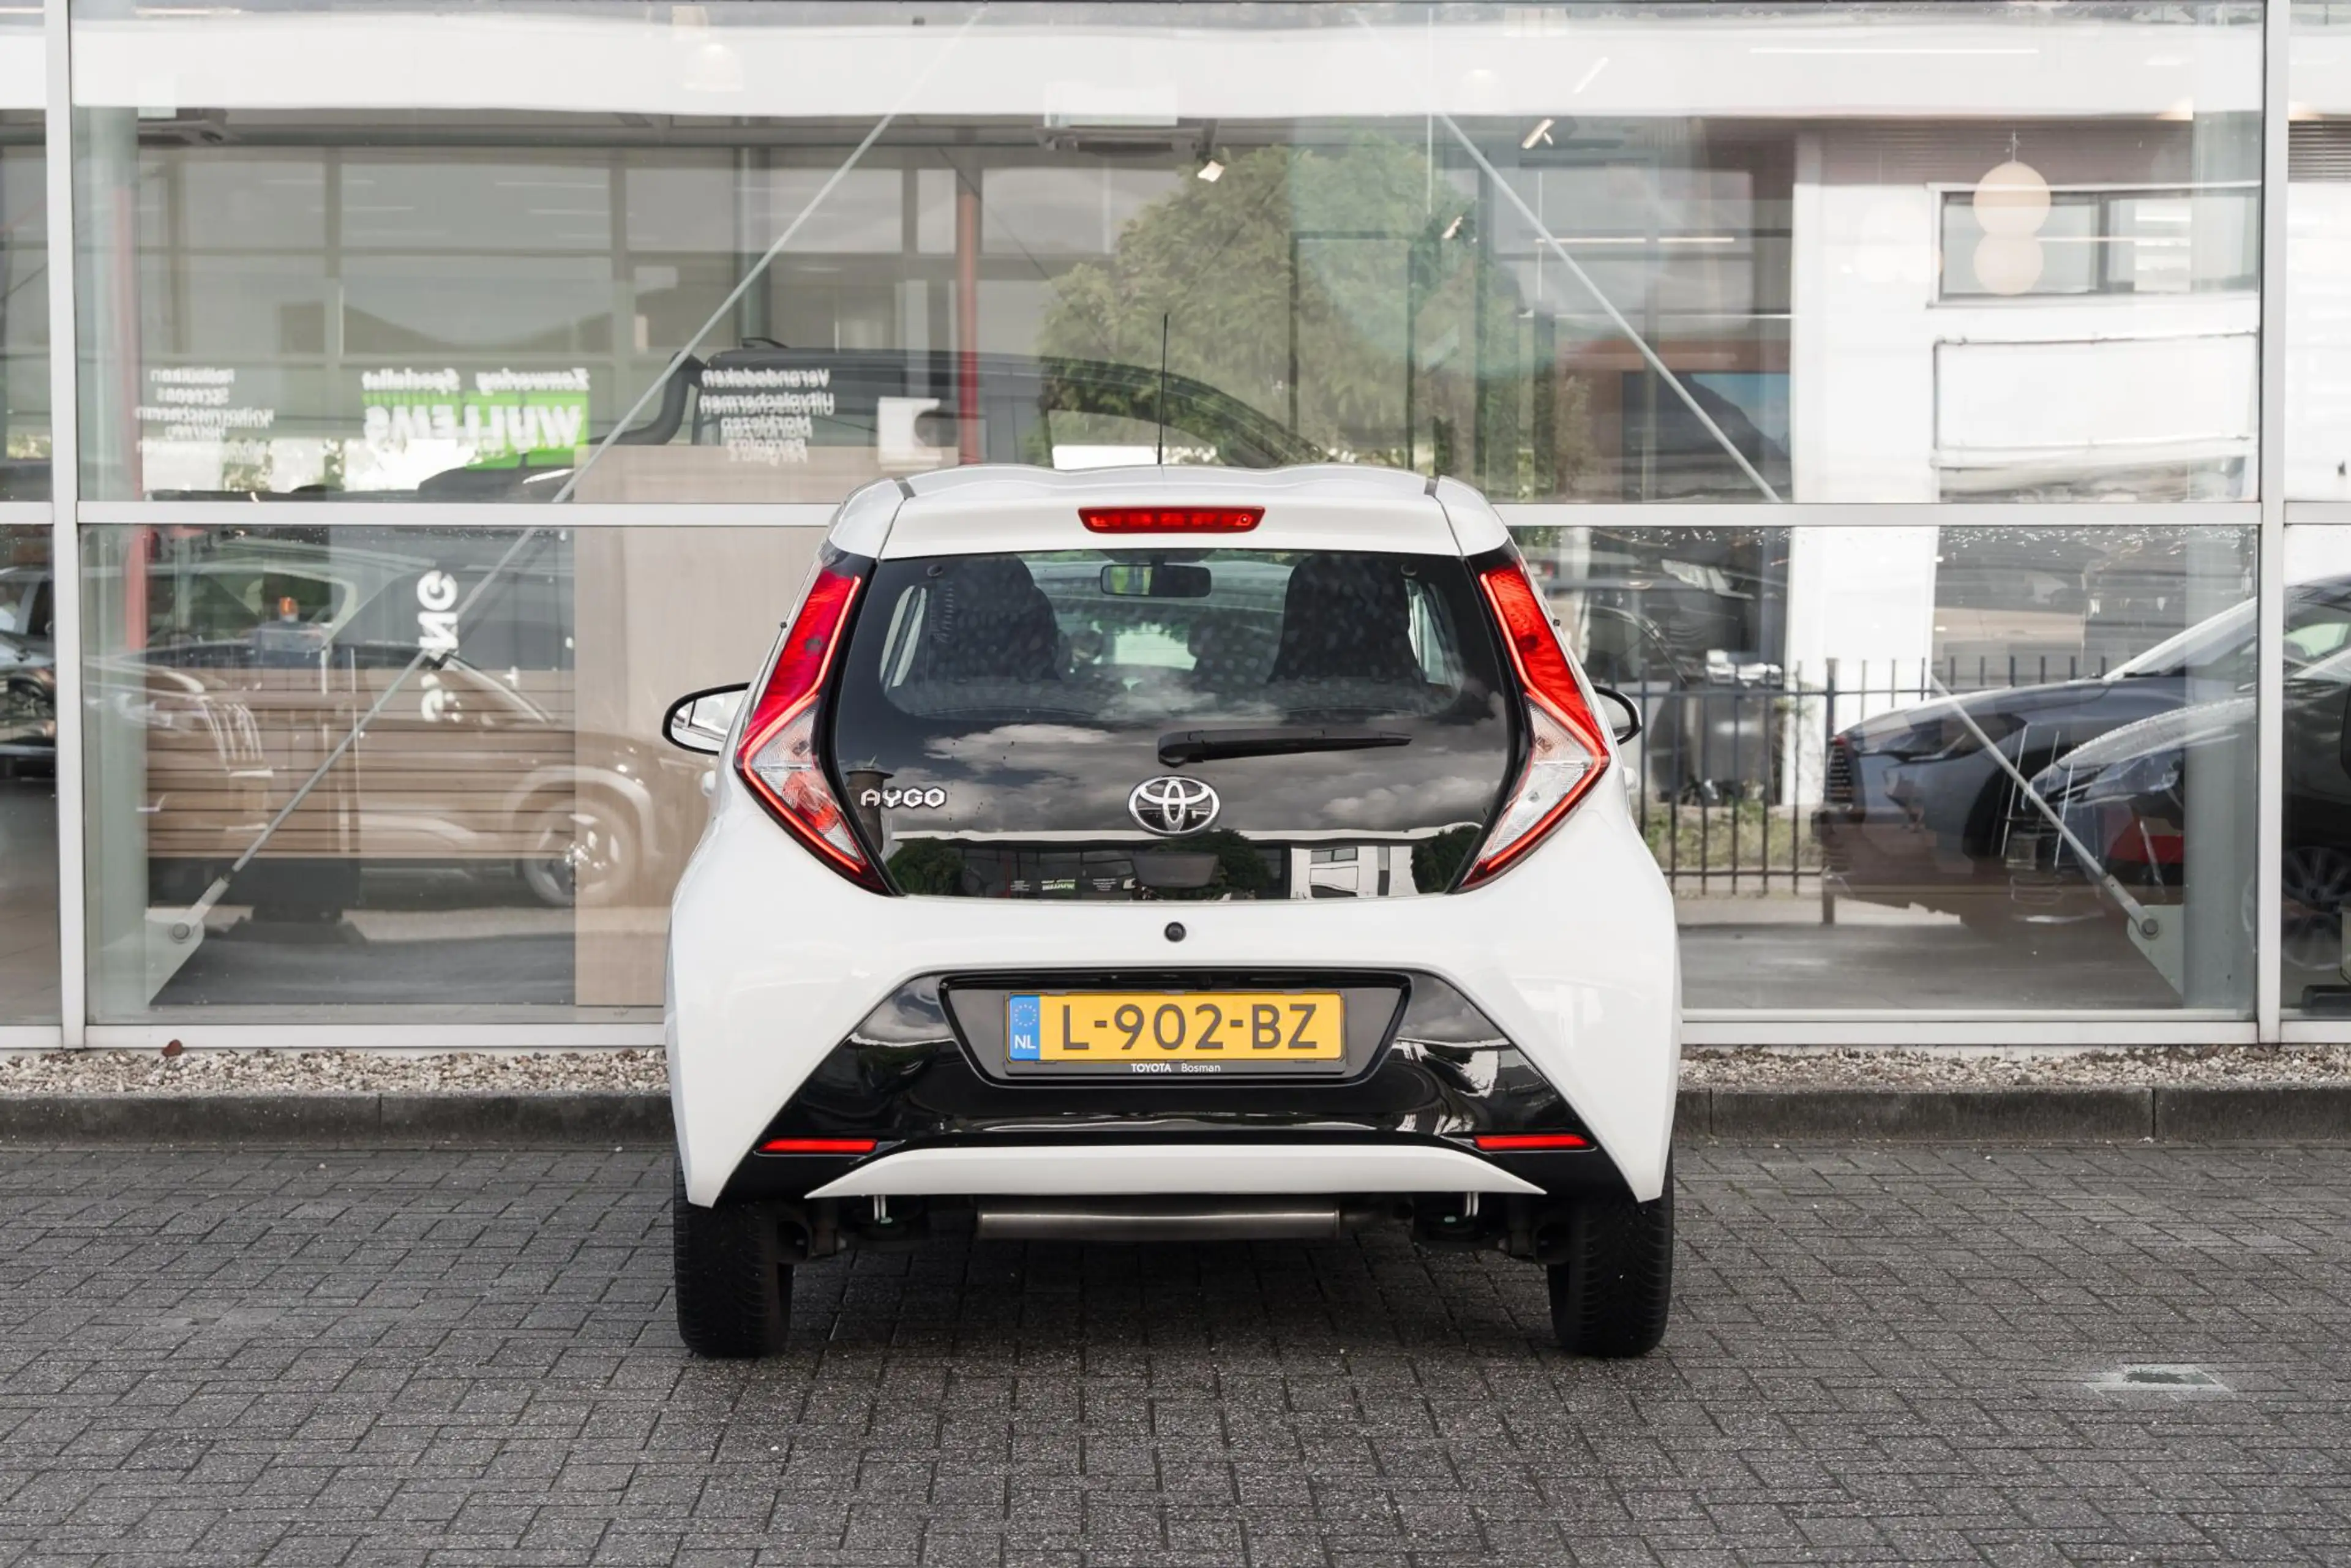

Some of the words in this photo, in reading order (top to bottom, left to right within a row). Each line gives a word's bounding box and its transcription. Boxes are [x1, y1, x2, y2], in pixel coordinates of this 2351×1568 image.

[860, 787, 946, 808] AYGO
[1014, 1035, 1037, 1049] NL
[1062, 1003, 1318, 1051] L-902-BZ
[1131, 1063, 1172, 1073] TOYOTA
[1181, 1063, 1221, 1073] Bosman
